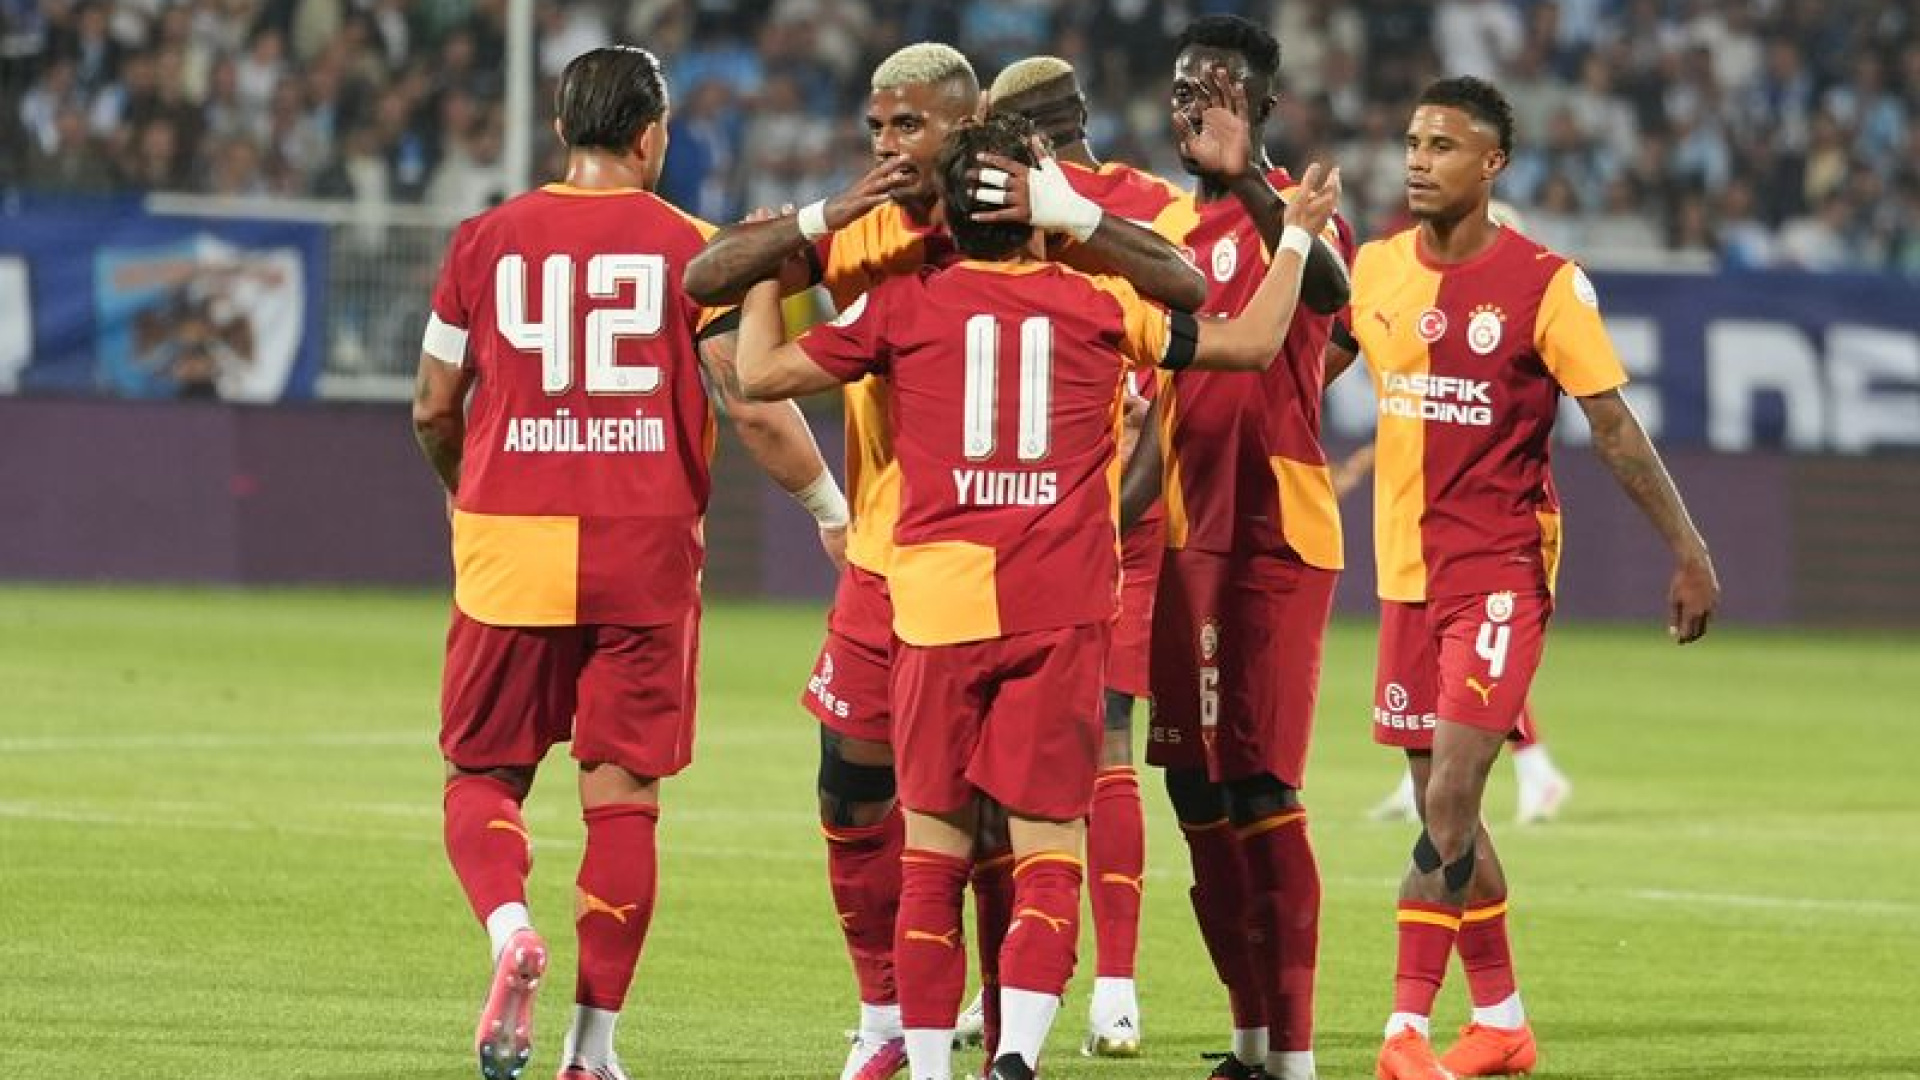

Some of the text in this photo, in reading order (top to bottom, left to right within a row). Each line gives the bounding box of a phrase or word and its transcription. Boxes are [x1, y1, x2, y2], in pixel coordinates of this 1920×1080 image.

[496, 253, 668, 395] 42
[964, 314, 1053, 461] 11
[952, 469, 1057, 505] YUNUS
[1475, 621, 1510, 677] 4
